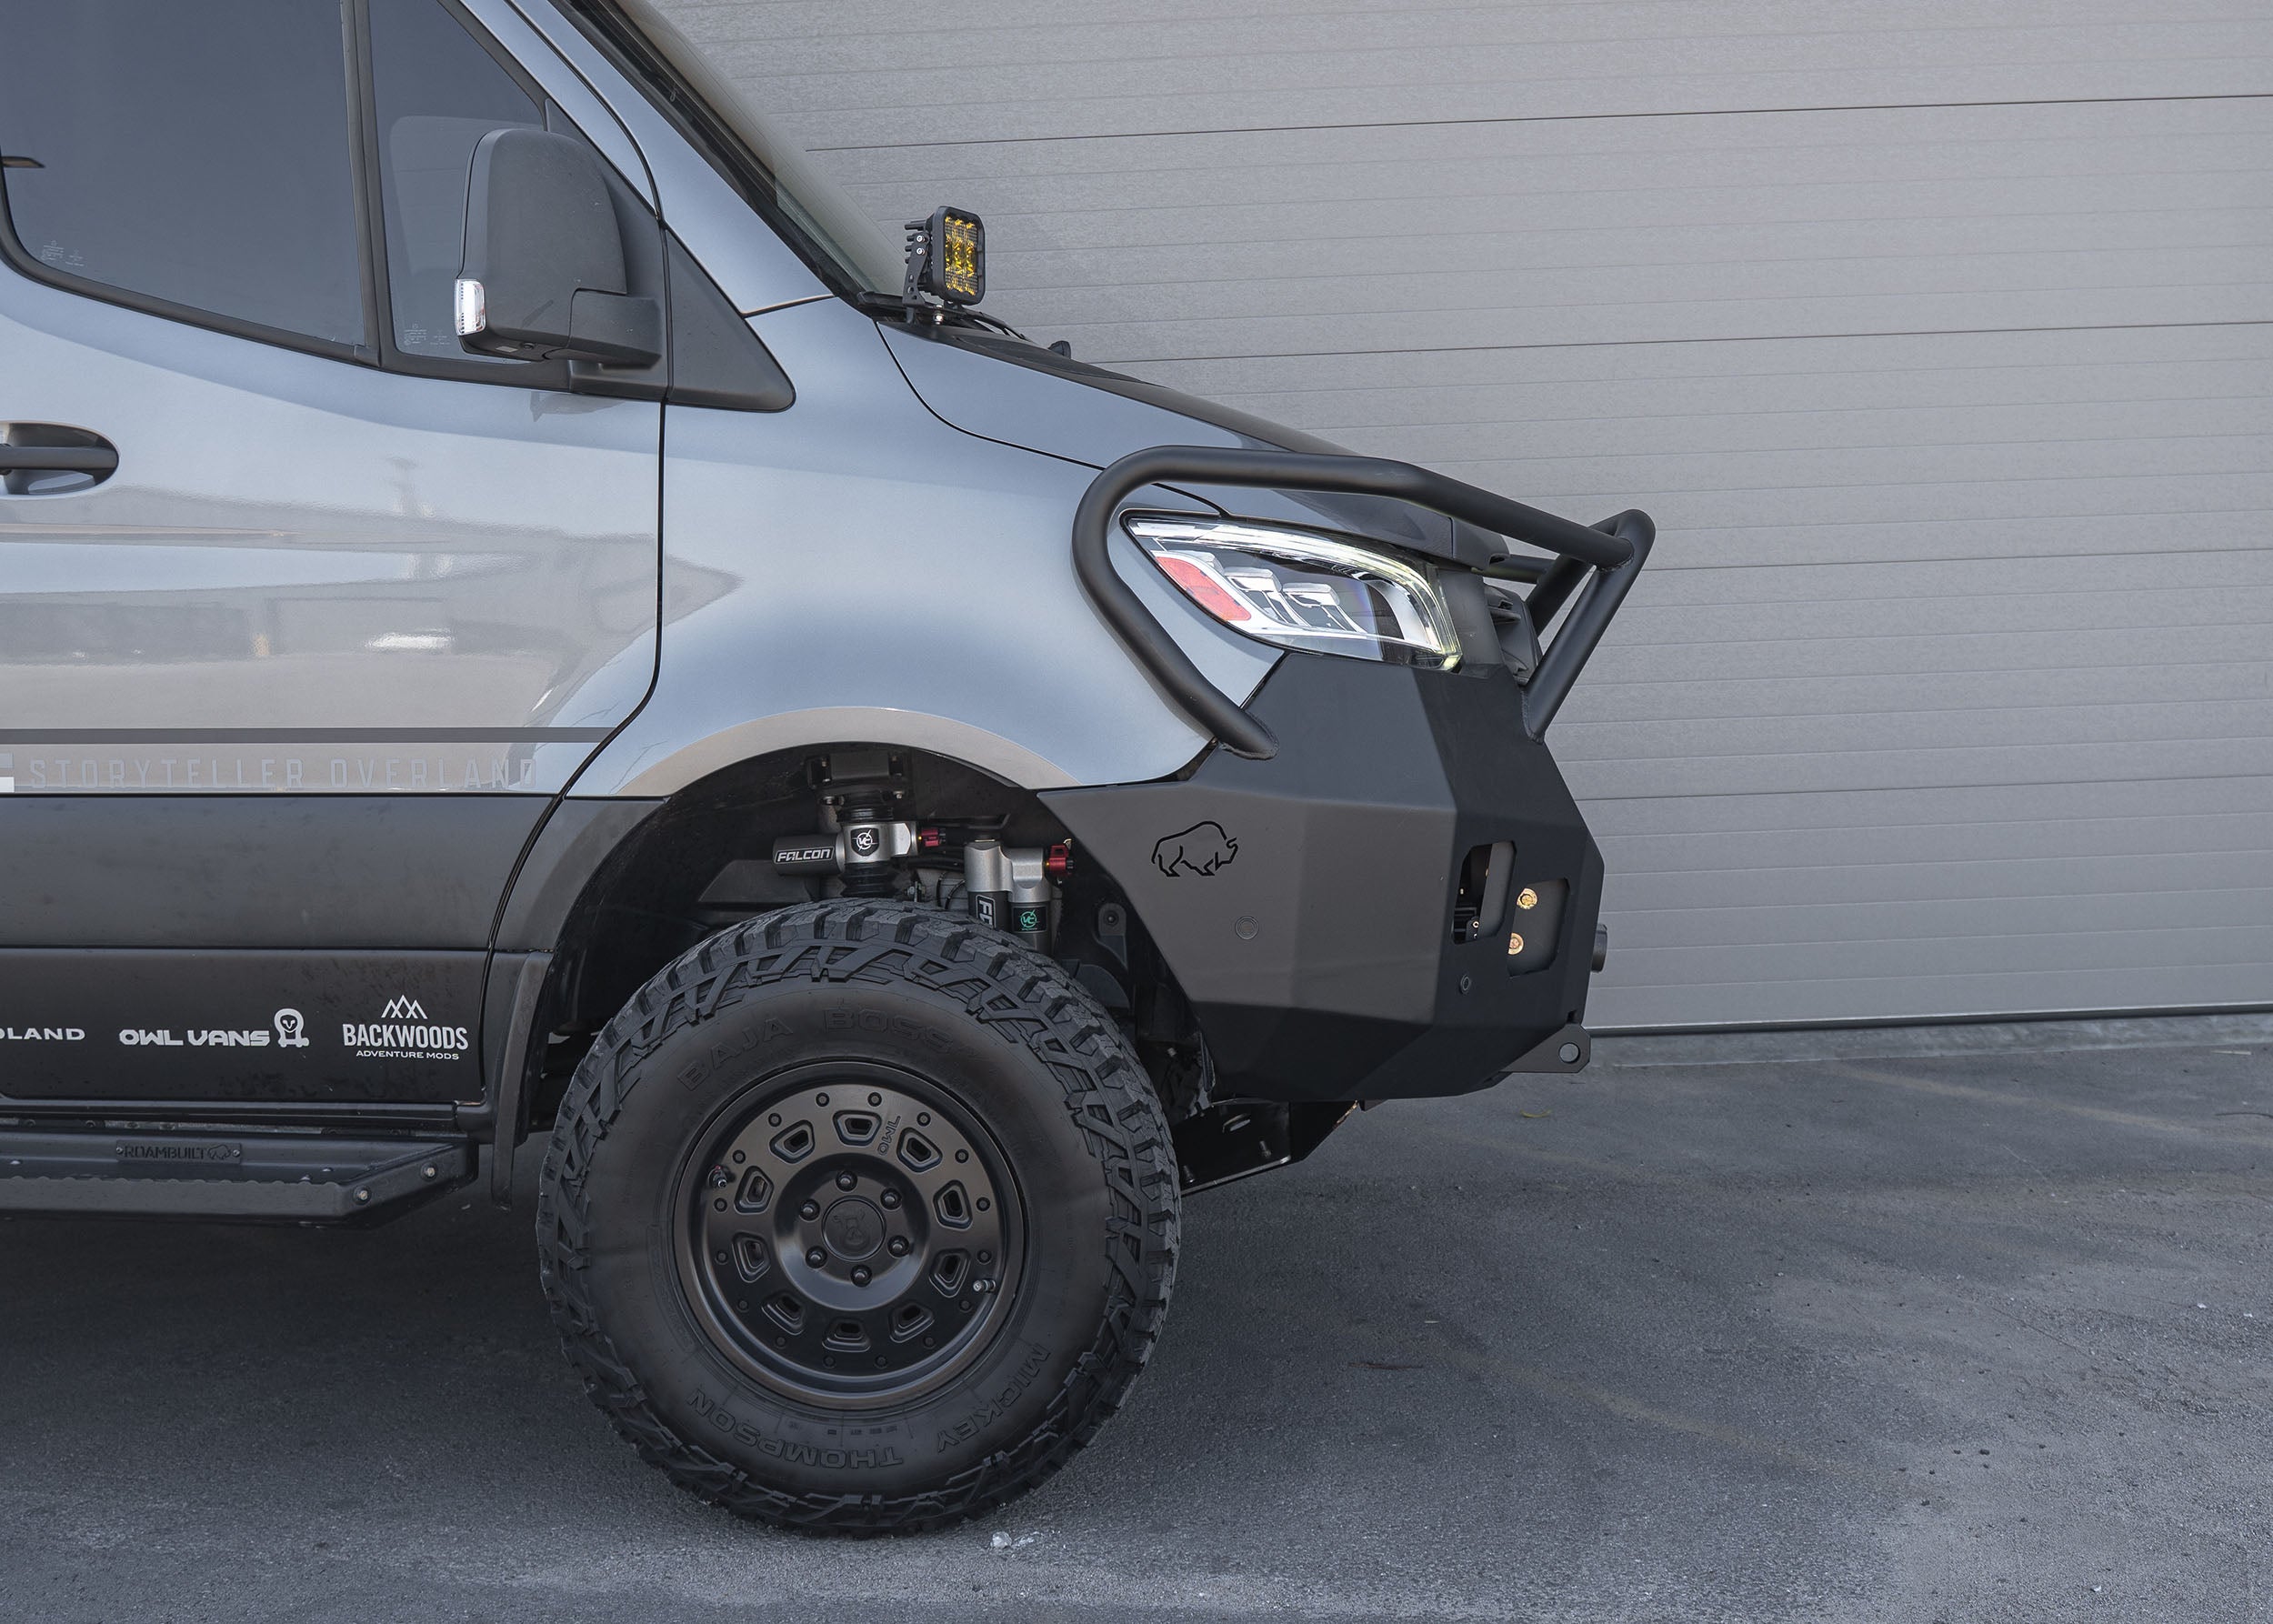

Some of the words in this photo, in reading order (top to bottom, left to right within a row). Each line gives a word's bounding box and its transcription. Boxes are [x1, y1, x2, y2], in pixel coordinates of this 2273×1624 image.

[29, 757, 305, 789] STORYTELLER
[330, 757, 538, 789] OVERLAND
[777, 848, 831, 862] FALCON
[0, 1027, 85, 1041] LAND
[119, 1029, 184, 1046] OWL
[187, 1029, 270, 1047] VANS
[342, 1023, 469, 1050] BACKWOODS
[355, 1049, 425, 1059] ADVENTURE
[426, 1051, 460, 1060] MODS
[676, 1017, 794, 1092] BAJA
[824, 1008, 954, 1053] BOSS
[876, 1115, 902, 1156] OWL
[124, 1145, 207, 1160] ROAMBUILT
[936, 1342, 1052, 1456] MICKEY
[685, 1387, 905, 1469] THOMPSON
